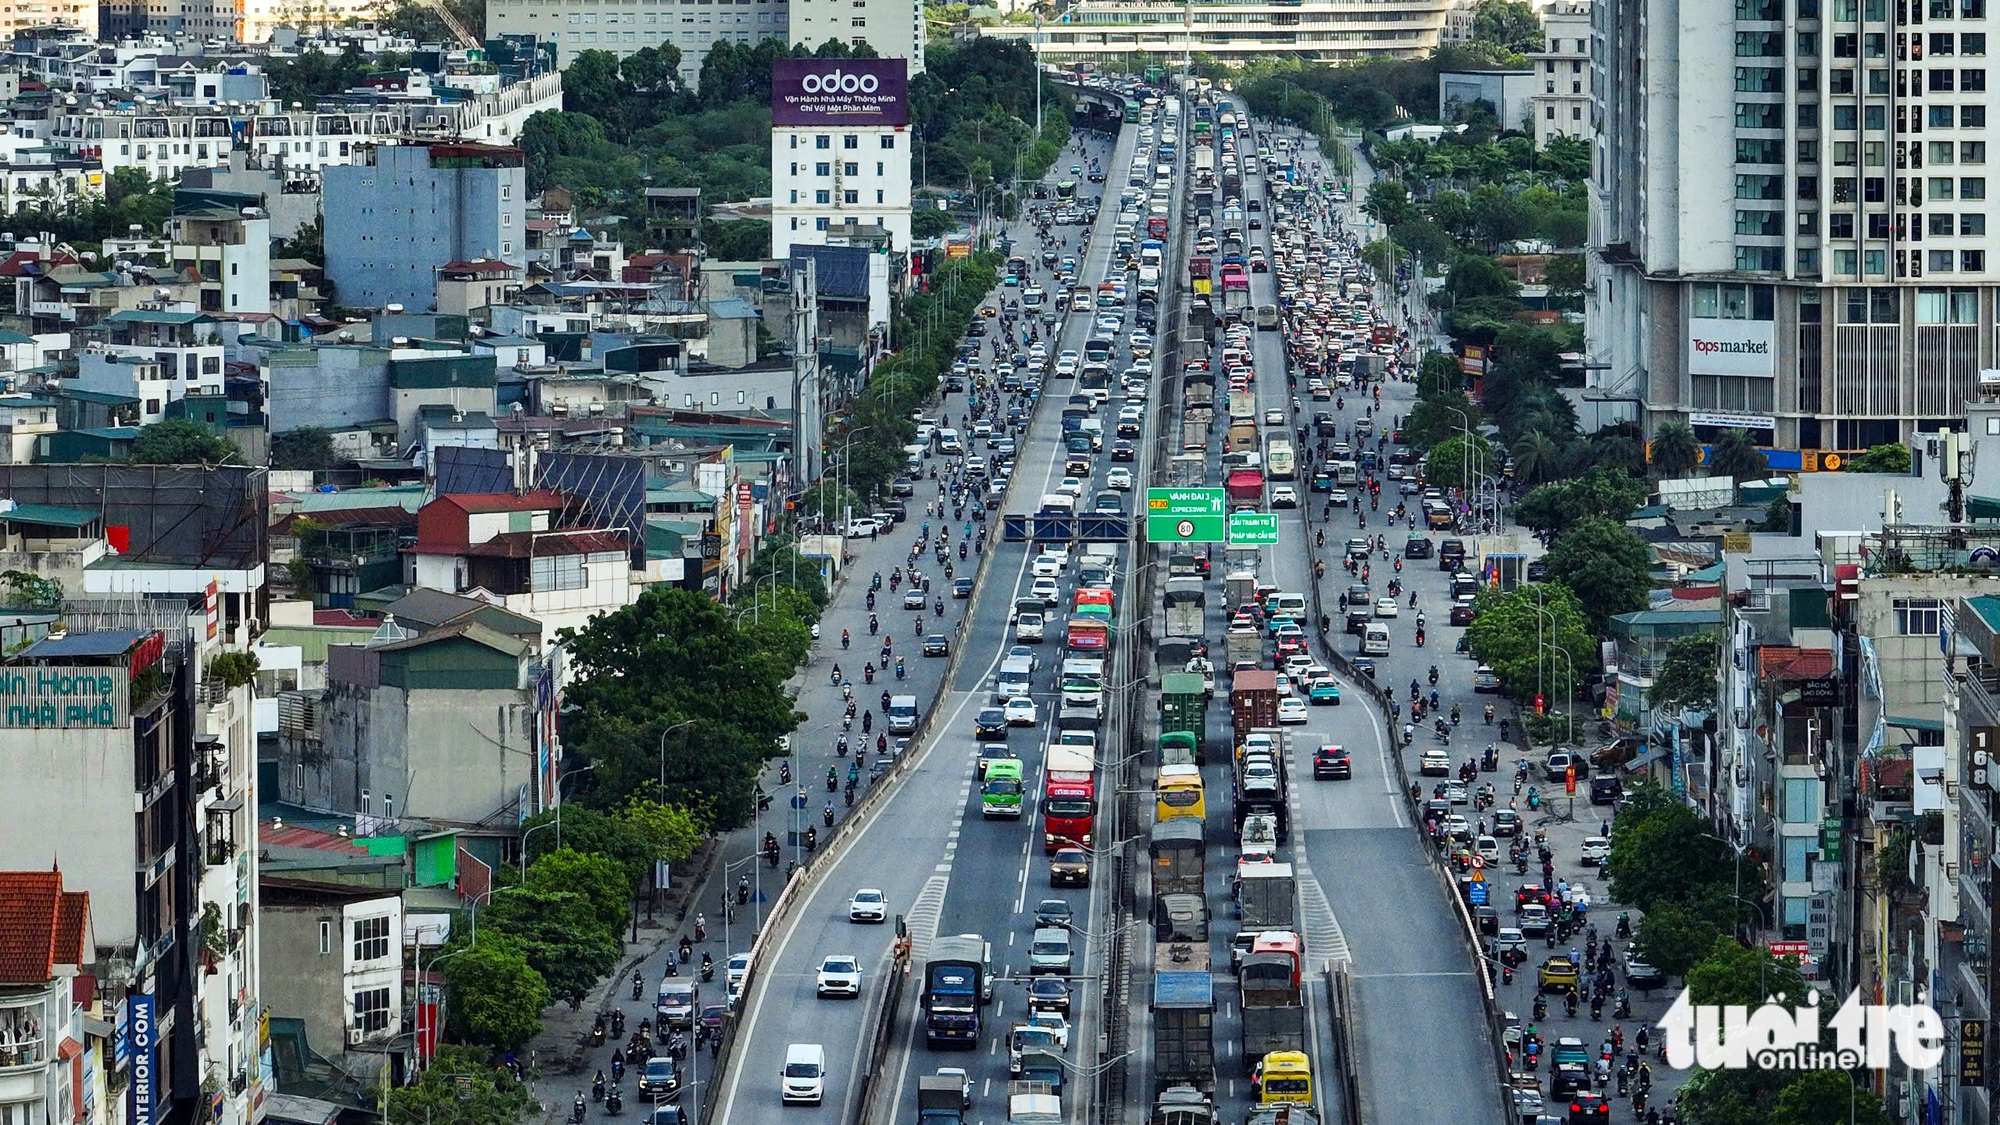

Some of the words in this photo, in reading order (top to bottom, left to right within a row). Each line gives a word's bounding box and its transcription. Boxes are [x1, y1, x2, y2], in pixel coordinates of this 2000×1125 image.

[802, 69, 879, 93] odoo
[785, 95, 799, 104] Vận
[800, 95, 819, 103] Hành
[821, 95, 835, 103] Nhà
[836, 95, 852, 104] Máy
[853, 95, 877, 104] Thông
[878, 95, 896, 103] Minh
[800, 104, 813, 112] Chỉ
[814, 104, 826, 112] Với
[827, 105, 842, 113] Một
[843, 104, 861, 112] Phần
[862, 104, 881, 112] Mềm
[1169, 492, 1190, 500] VÀNH
[1180, 524, 1191, 533] 80
[37, 671, 113, 695] Home
[1973, 732, 1988, 785] 168
[1810, 913, 1826, 923] KHOA
[1812, 928, 1825, 938] OTIS
